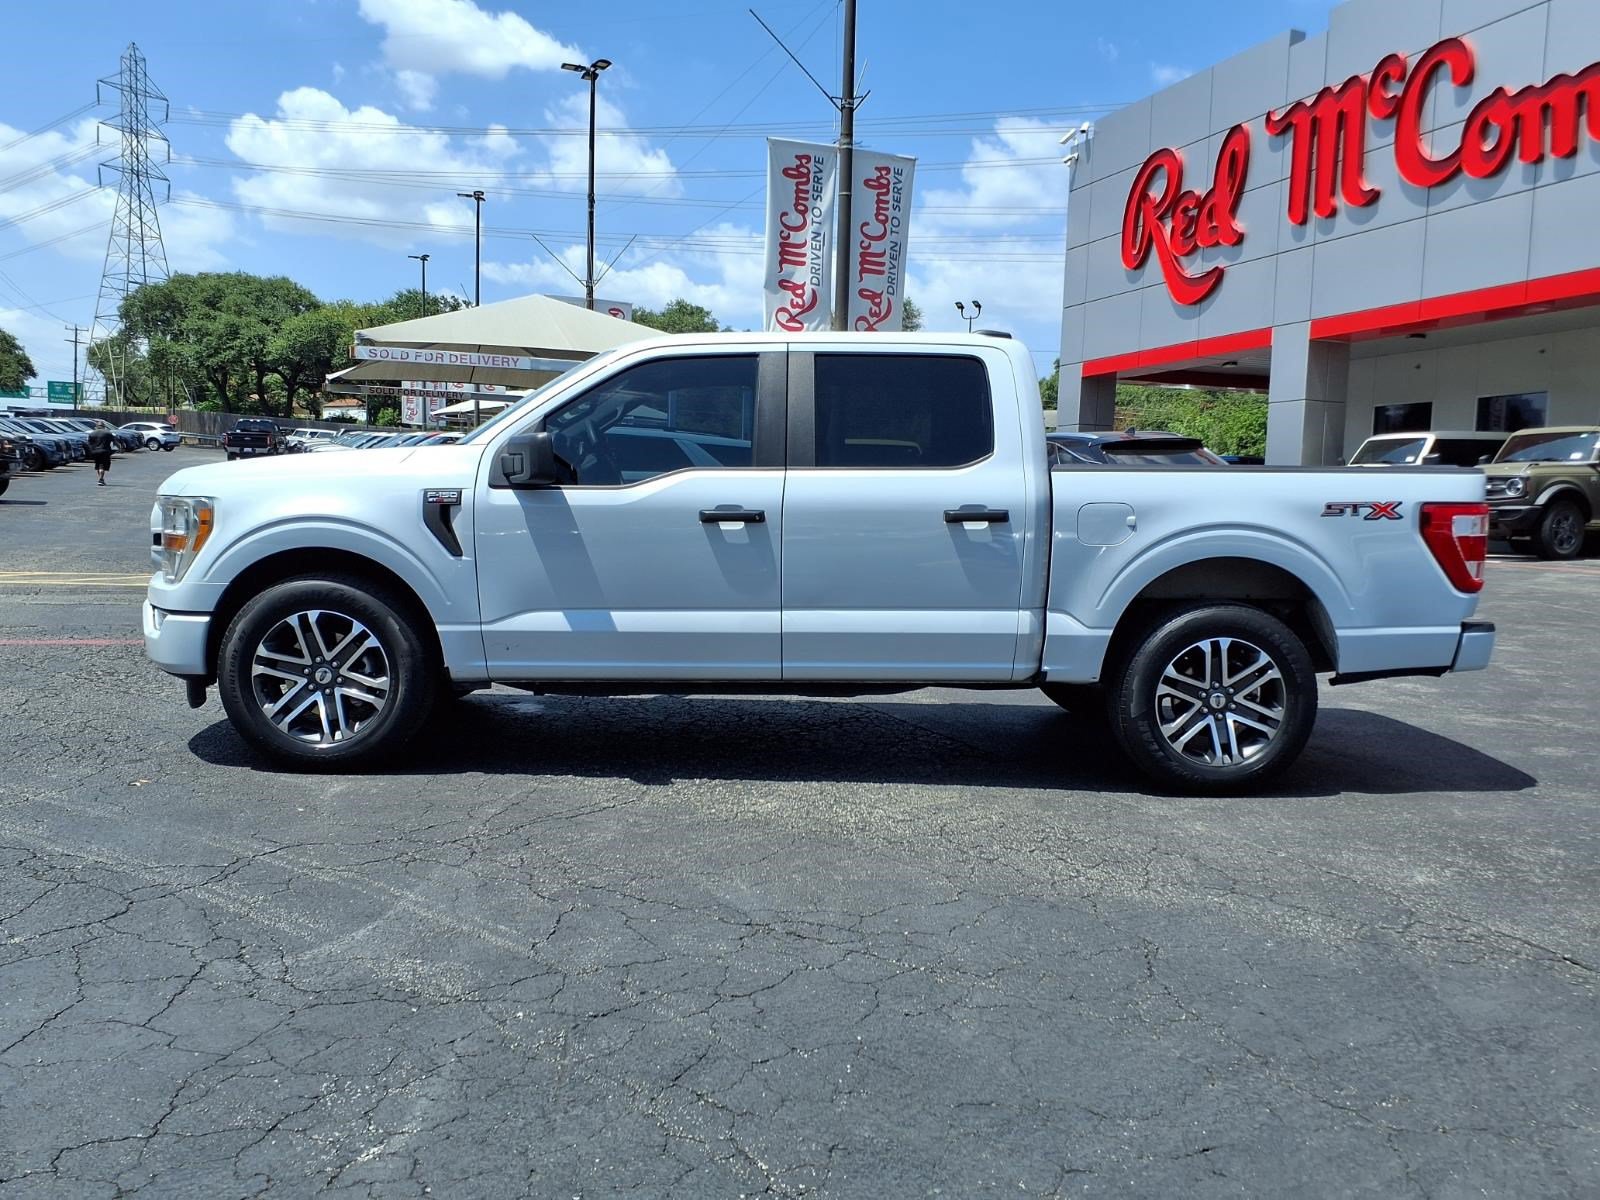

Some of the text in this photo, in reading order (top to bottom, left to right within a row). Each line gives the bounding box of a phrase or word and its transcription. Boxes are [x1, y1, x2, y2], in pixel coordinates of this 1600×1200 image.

[775, 154, 817, 332] Red McCombs
[810, 155, 824, 287] DRIVEN TO SERVE
[858, 166, 891, 283] McCombs
[887, 166, 903, 296] DRIVEN TO SERVE
[1121, 123, 1250, 306] Red
[368, 348, 520, 367] SOLD FOR DELIVERY
[369, 387, 465, 399] SOLD FOR DELIVERY
[1321, 501, 1404, 520] STX
